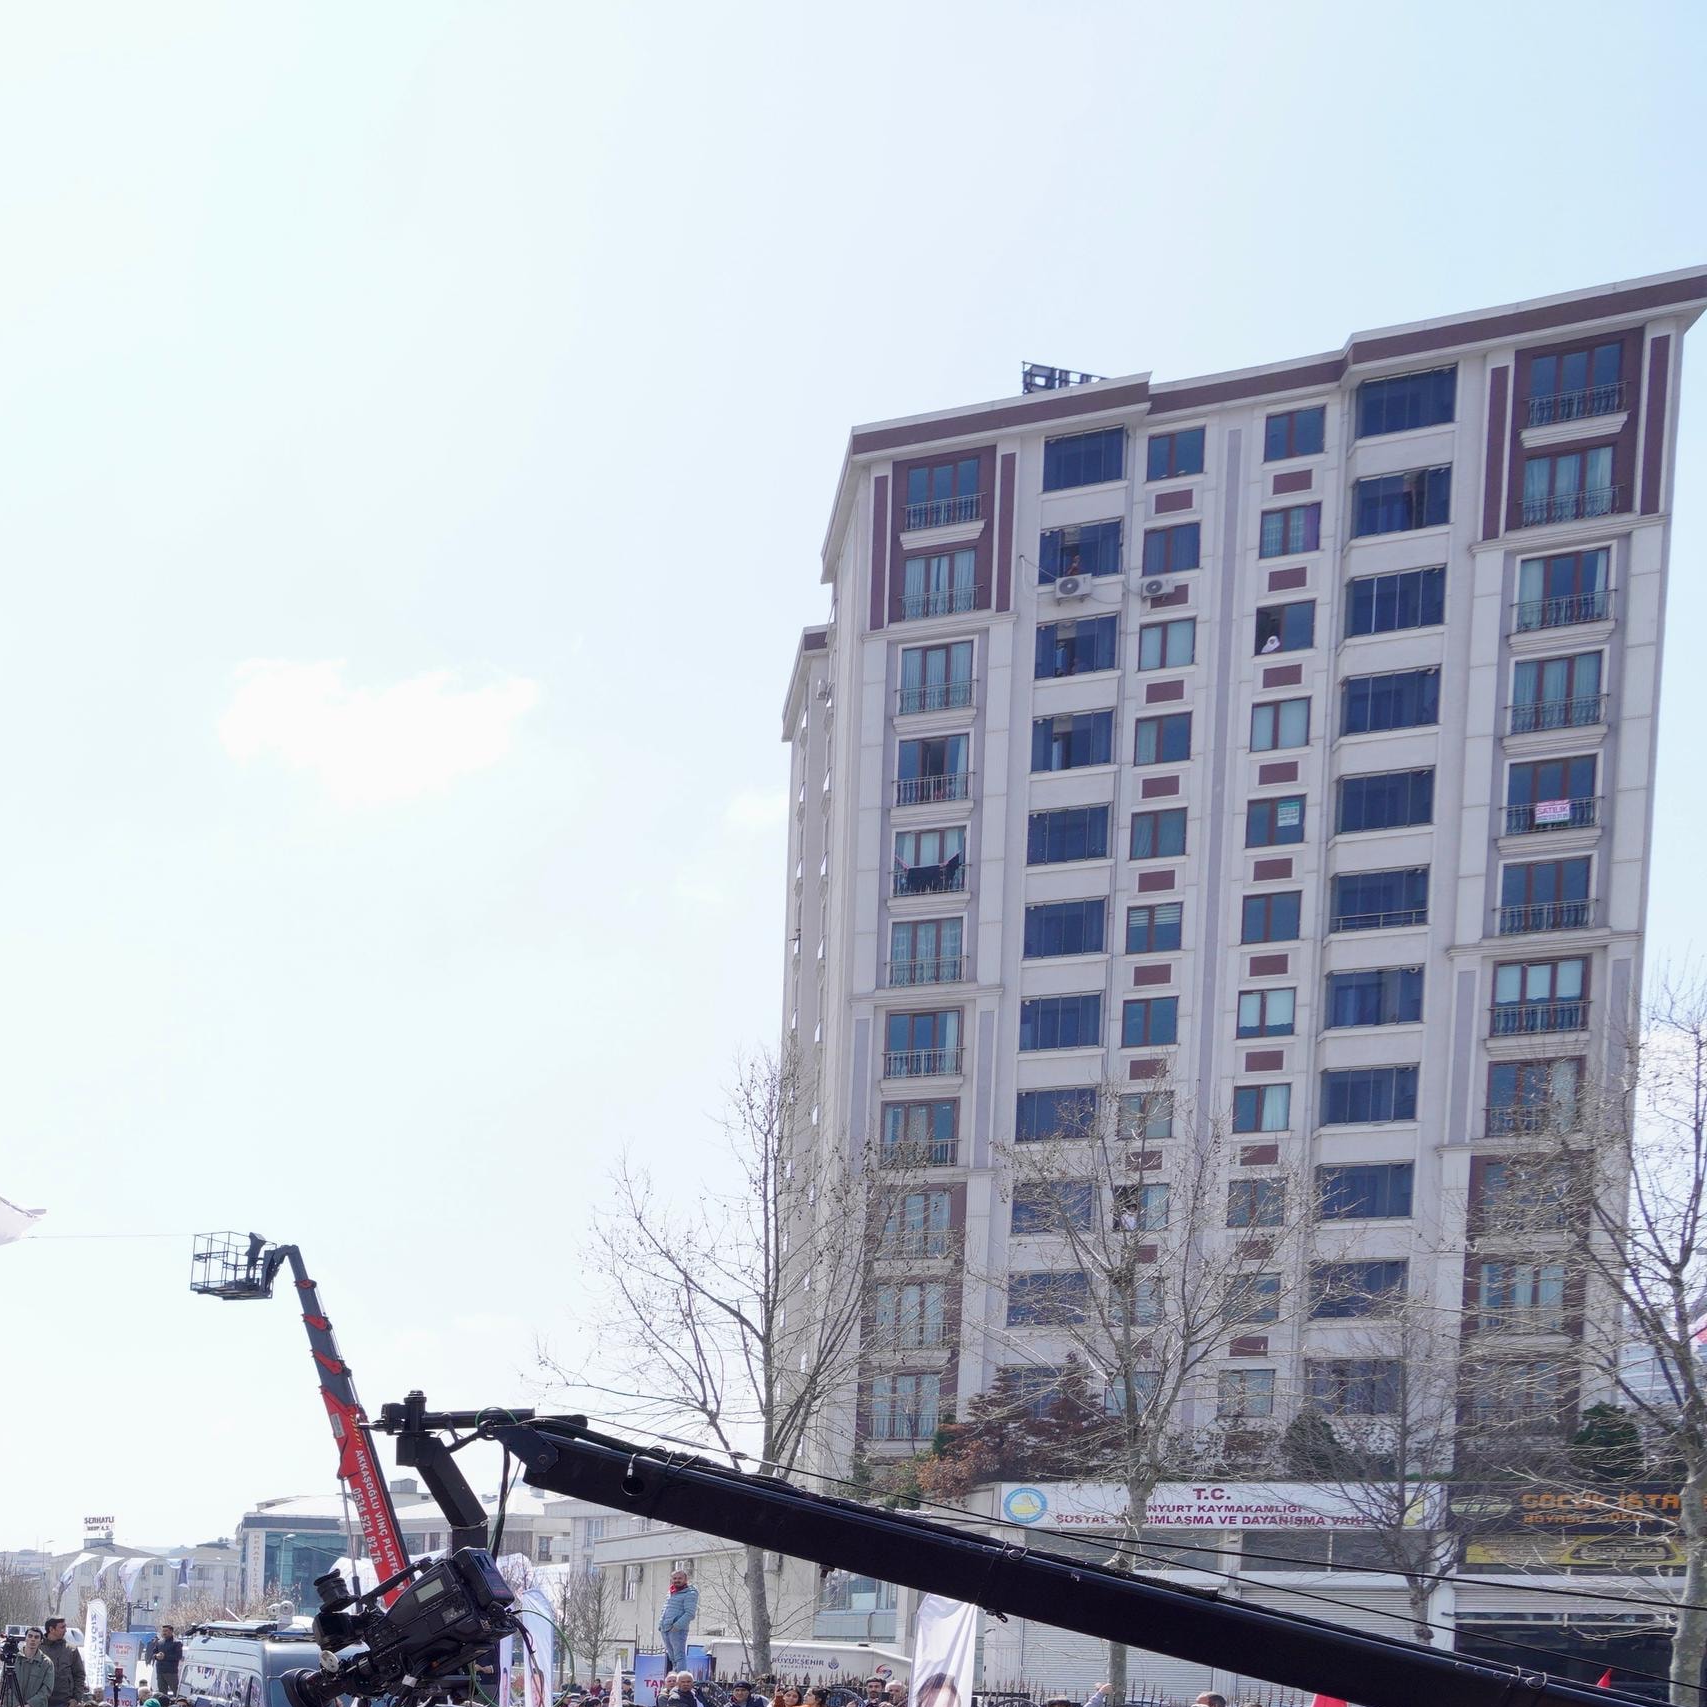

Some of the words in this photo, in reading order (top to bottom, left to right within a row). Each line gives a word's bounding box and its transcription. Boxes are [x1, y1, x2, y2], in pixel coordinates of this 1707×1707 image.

[352, 1487, 367, 1513] 0534
[1192, 1487, 1232, 1501] T.C.
[355, 1449, 380, 1510] AKKAŞOĞLU
[375, 1511, 389, 1537] VİNÇ
[382, 1537, 406, 1591] PLATFOM
[360, 1514, 373, 1533] 521
[1055, 1513, 1108, 1525] SOSYAL
[1219, 1514, 1238, 1526] VE
[366, 1535, 378, 1549] 82
